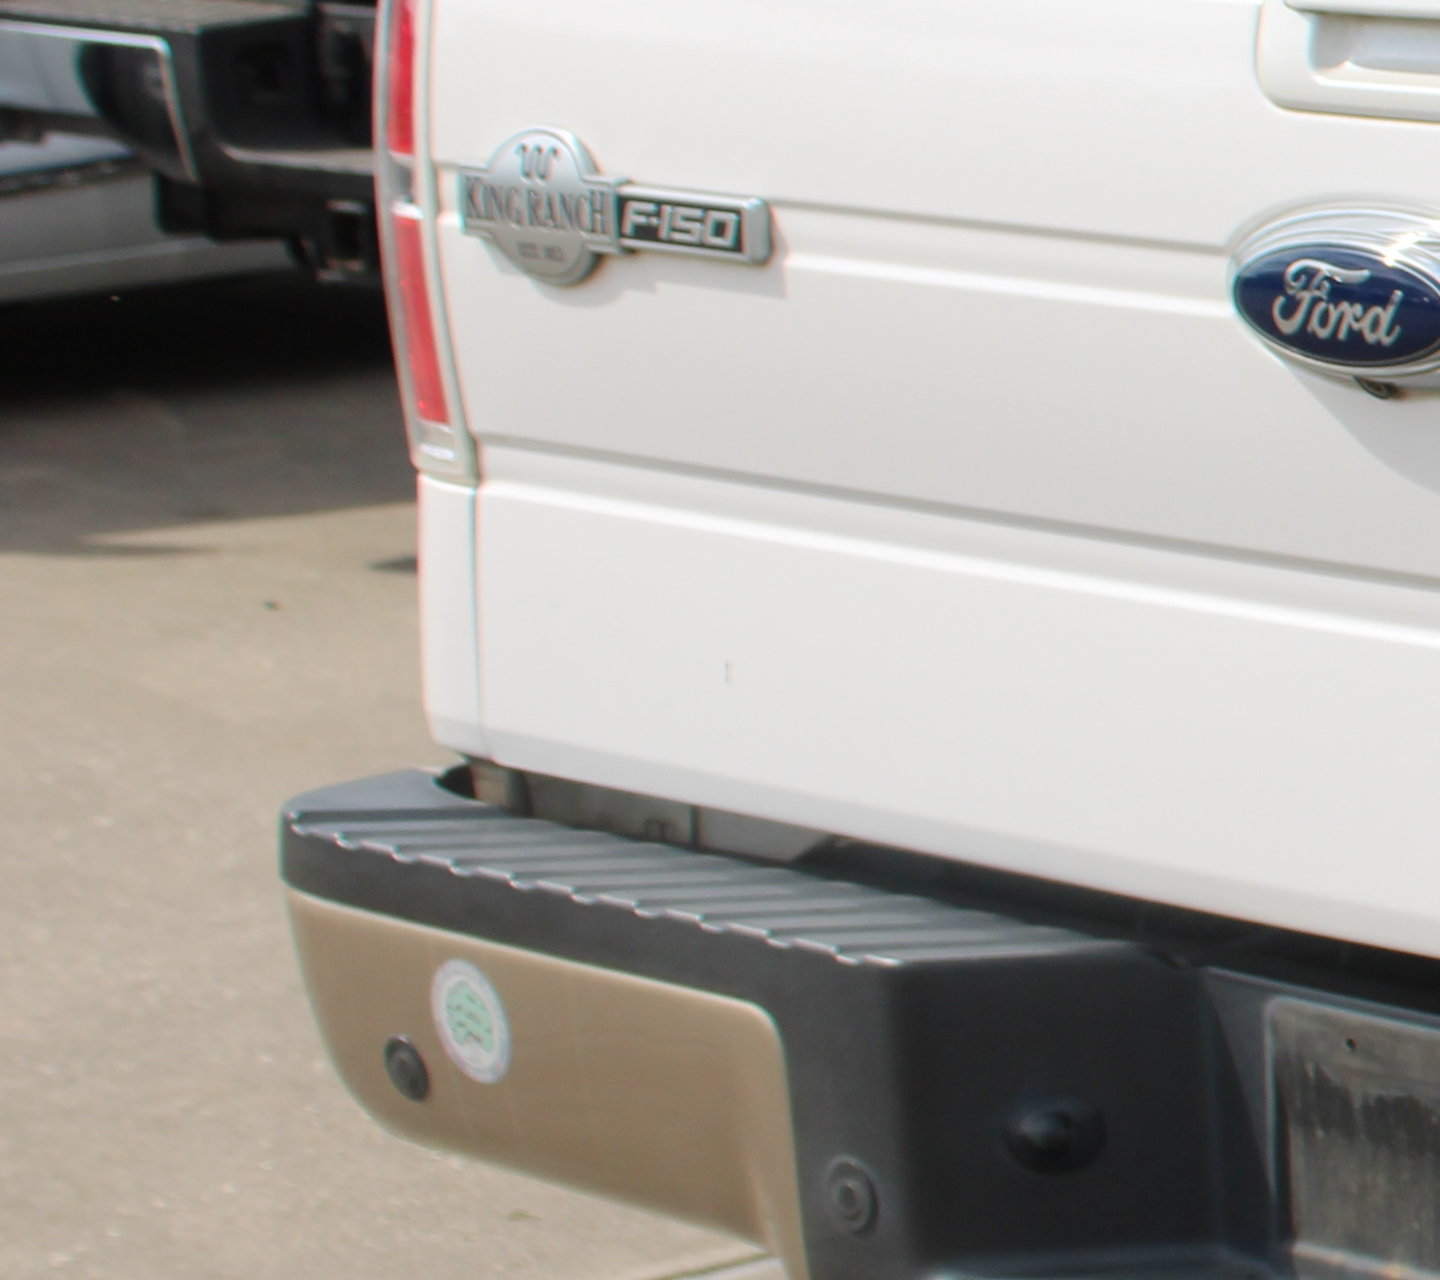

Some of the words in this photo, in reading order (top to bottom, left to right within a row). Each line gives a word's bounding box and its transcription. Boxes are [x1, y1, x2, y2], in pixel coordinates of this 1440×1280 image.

[465, 176, 525, 222] KING
[529, 187, 611, 235] RANCH
[623, 200, 738, 247] F-150
[1272, 257, 1404, 347] Ford
